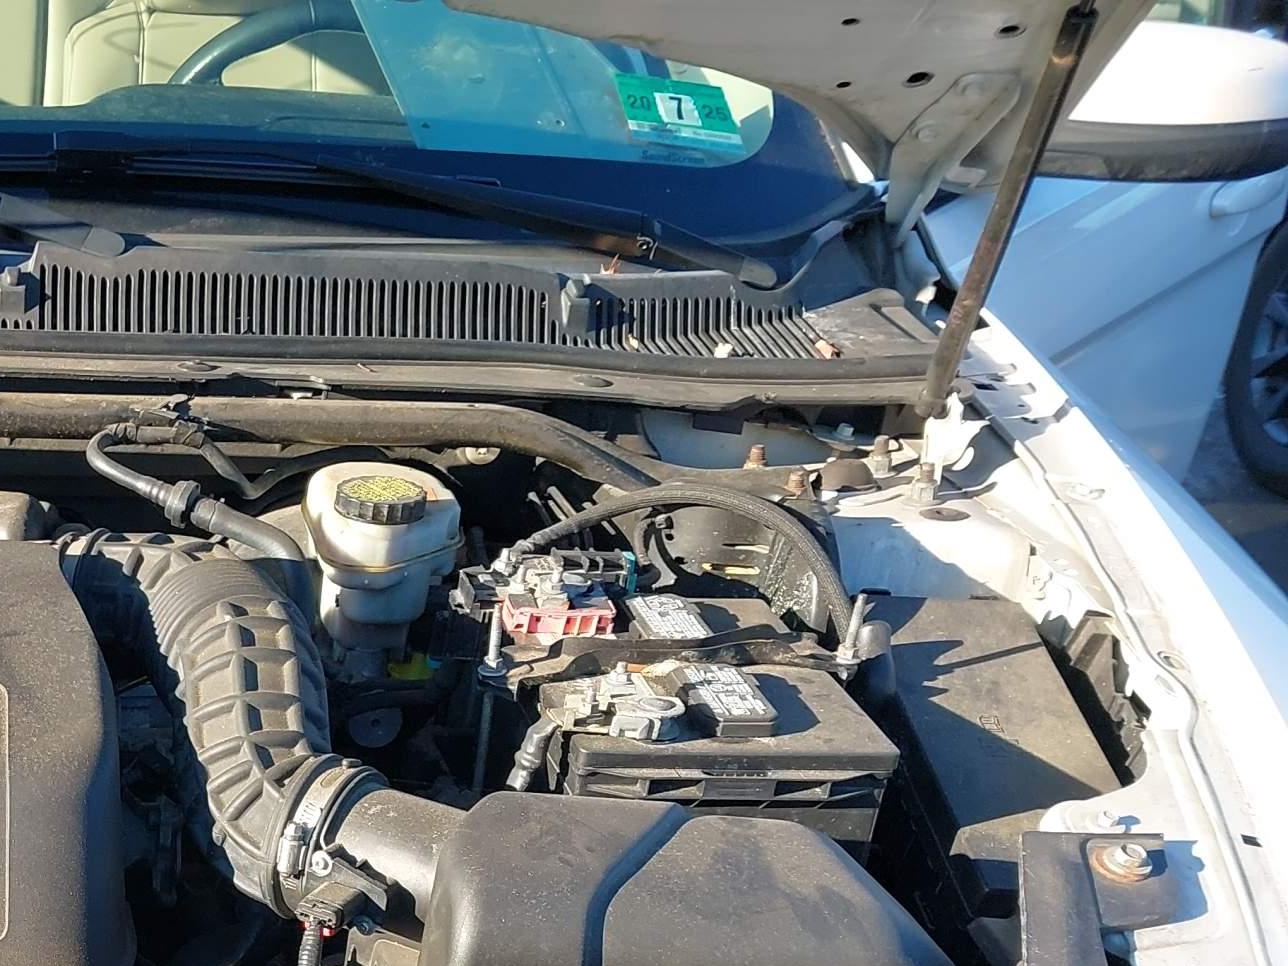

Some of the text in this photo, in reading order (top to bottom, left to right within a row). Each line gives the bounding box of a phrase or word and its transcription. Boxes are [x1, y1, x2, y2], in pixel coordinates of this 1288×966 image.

[627, 94, 728, 121] 20 7 25
